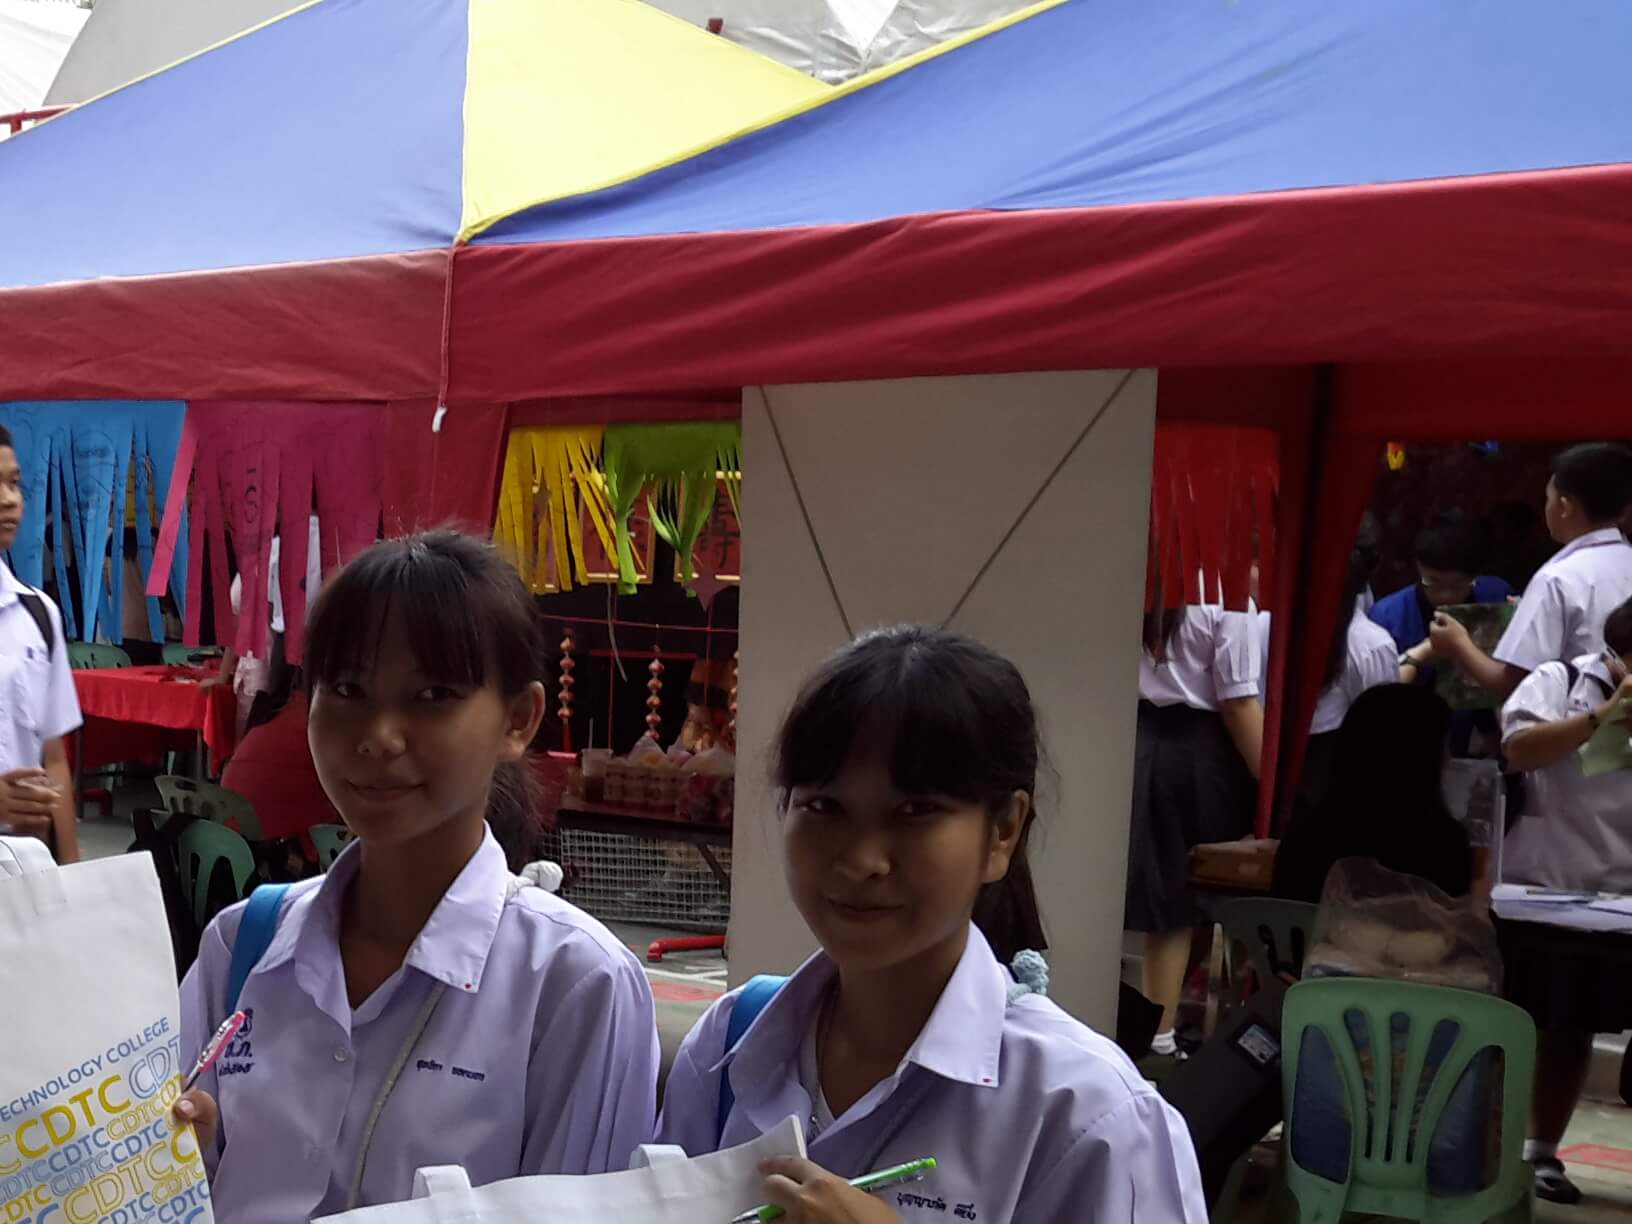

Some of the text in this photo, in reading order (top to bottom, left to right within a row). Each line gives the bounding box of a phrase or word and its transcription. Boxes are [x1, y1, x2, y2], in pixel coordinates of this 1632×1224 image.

[104, 1015, 174, 1064] COLLEGE
[12, 1071, 136, 1159] CDTC
[46, 1125, 113, 1172] CDTC
[108, 1117, 172, 1163] CDTC
[154, 1177, 215, 1223] CDTC
